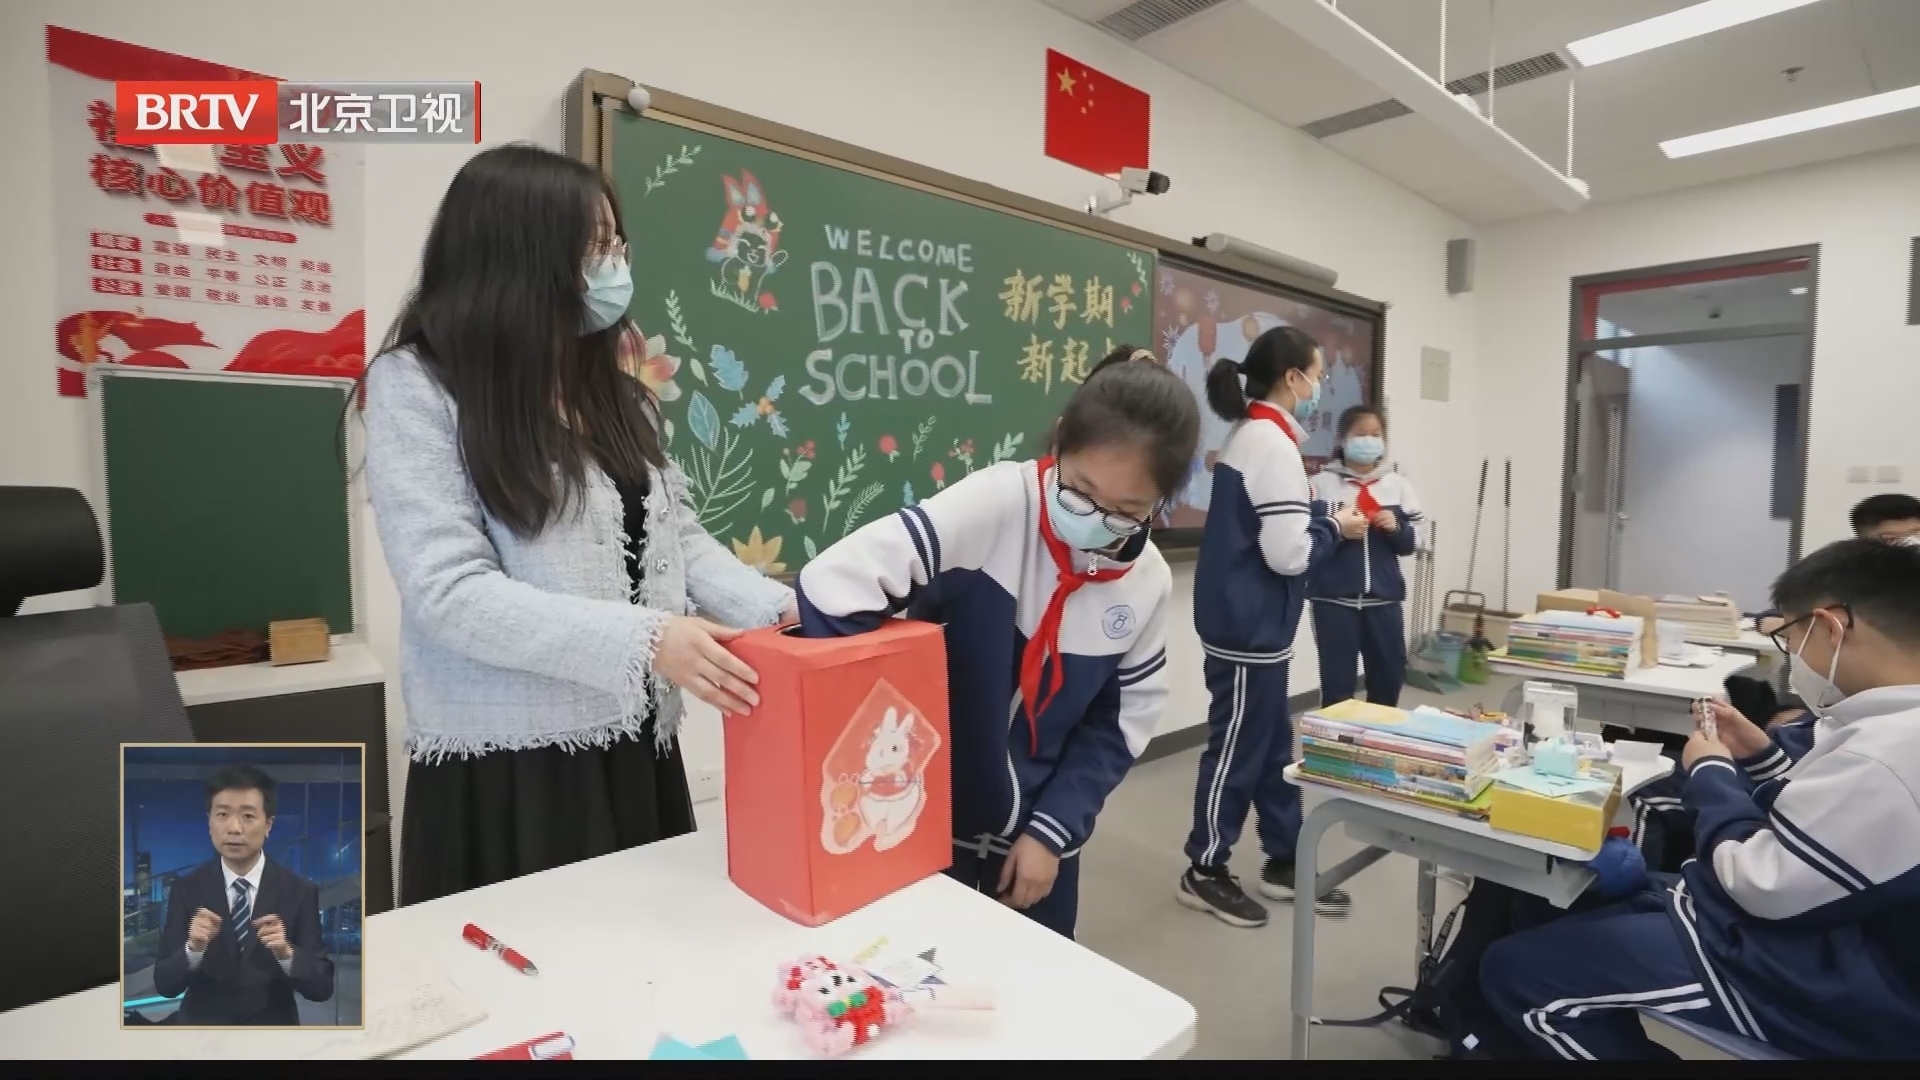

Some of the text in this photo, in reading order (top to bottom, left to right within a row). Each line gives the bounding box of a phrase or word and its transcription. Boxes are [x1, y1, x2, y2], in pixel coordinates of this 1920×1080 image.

[90, 154, 333, 225] 核心价值观
[153, 241, 190, 256] 富强
[206, 247, 239, 262] 民主
[254, 254, 287, 268] 文明
[300, 260, 332, 274] 和谐
[824, 224, 974, 273] WELCOME
[97, 256, 332, 293] 社会 自由 平等 公正 法治
[98, 279, 332, 313] 公民 爱国 敬业 诚信 友善
[999, 268, 1115, 330] 新学期
[809, 261, 969, 342] BACK
[899, 329, 935, 354] TO
[798, 350, 992, 406] SCHOOL
